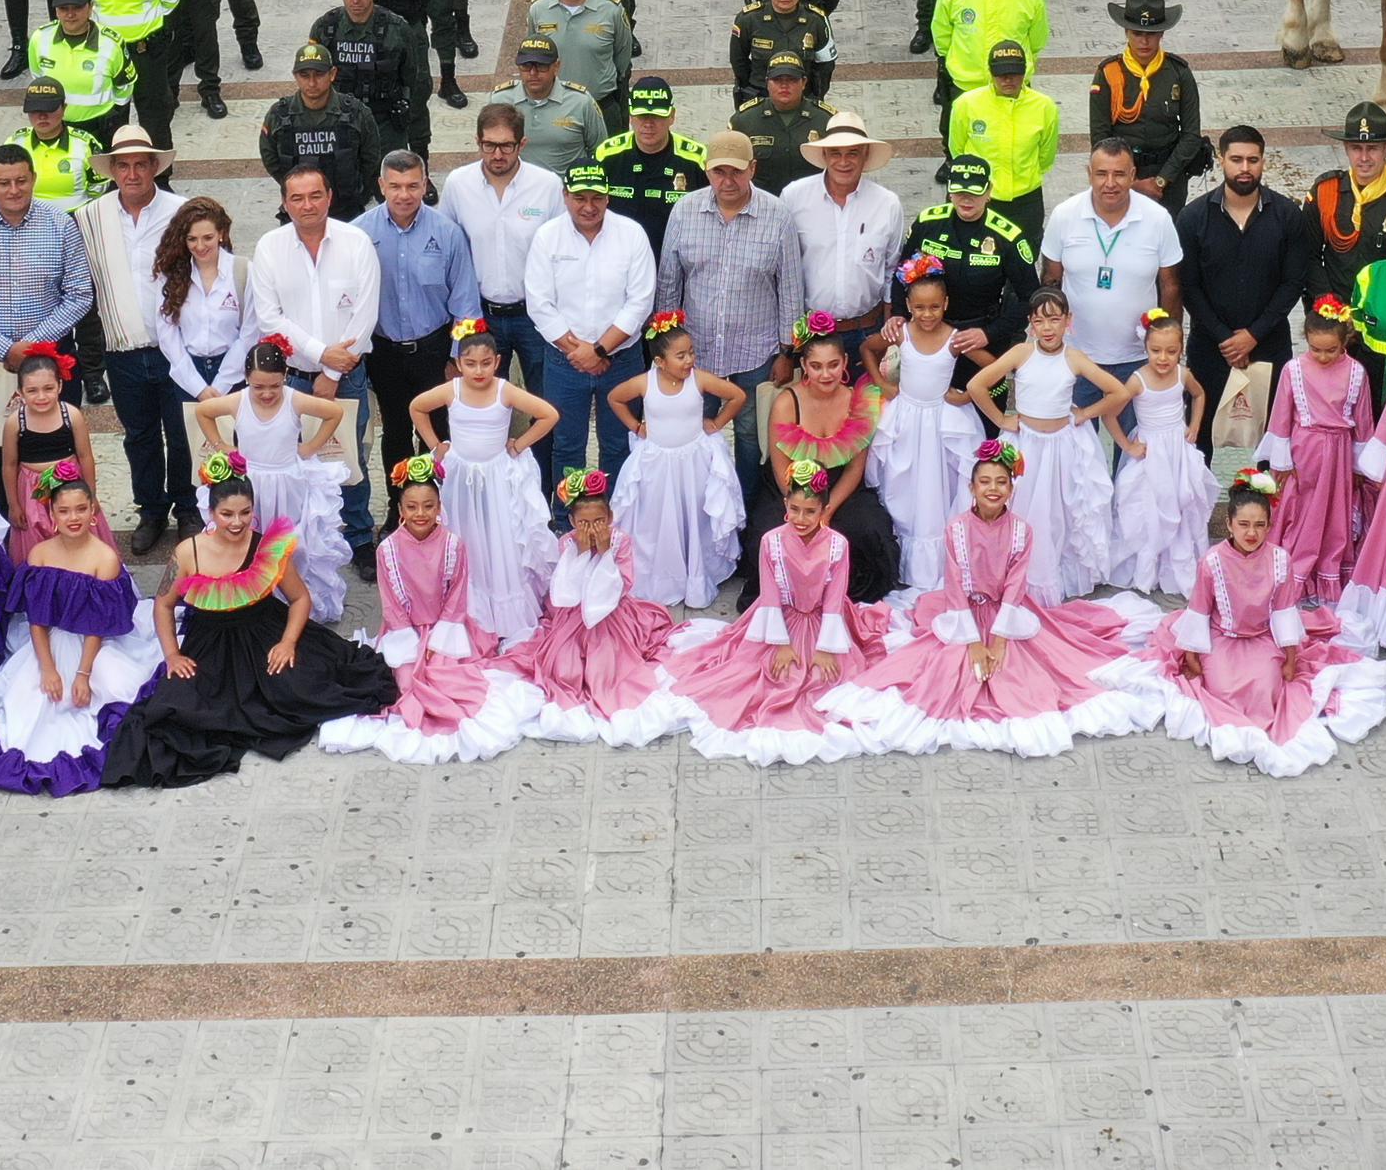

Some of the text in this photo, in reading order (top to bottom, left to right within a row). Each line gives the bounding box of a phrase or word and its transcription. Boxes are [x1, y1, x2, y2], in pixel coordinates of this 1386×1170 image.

[337, 41, 374, 54] POLICIA
[521, 39, 550, 50] POLICIA
[338, 53, 371, 63] GAULA
[992, 48, 1023, 59] POLICIA
[770, 56, 800, 67] POLICIA
[25, 84, 58, 96] POLICIA
[633, 88, 668, 100] POLICÍA
[295, 131, 336, 144] POLICIA
[298, 143, 334, 155] GAULA
[569, 165, 604, 177] POLICÍA
[951, 164, 986, 175] POLICÍA
